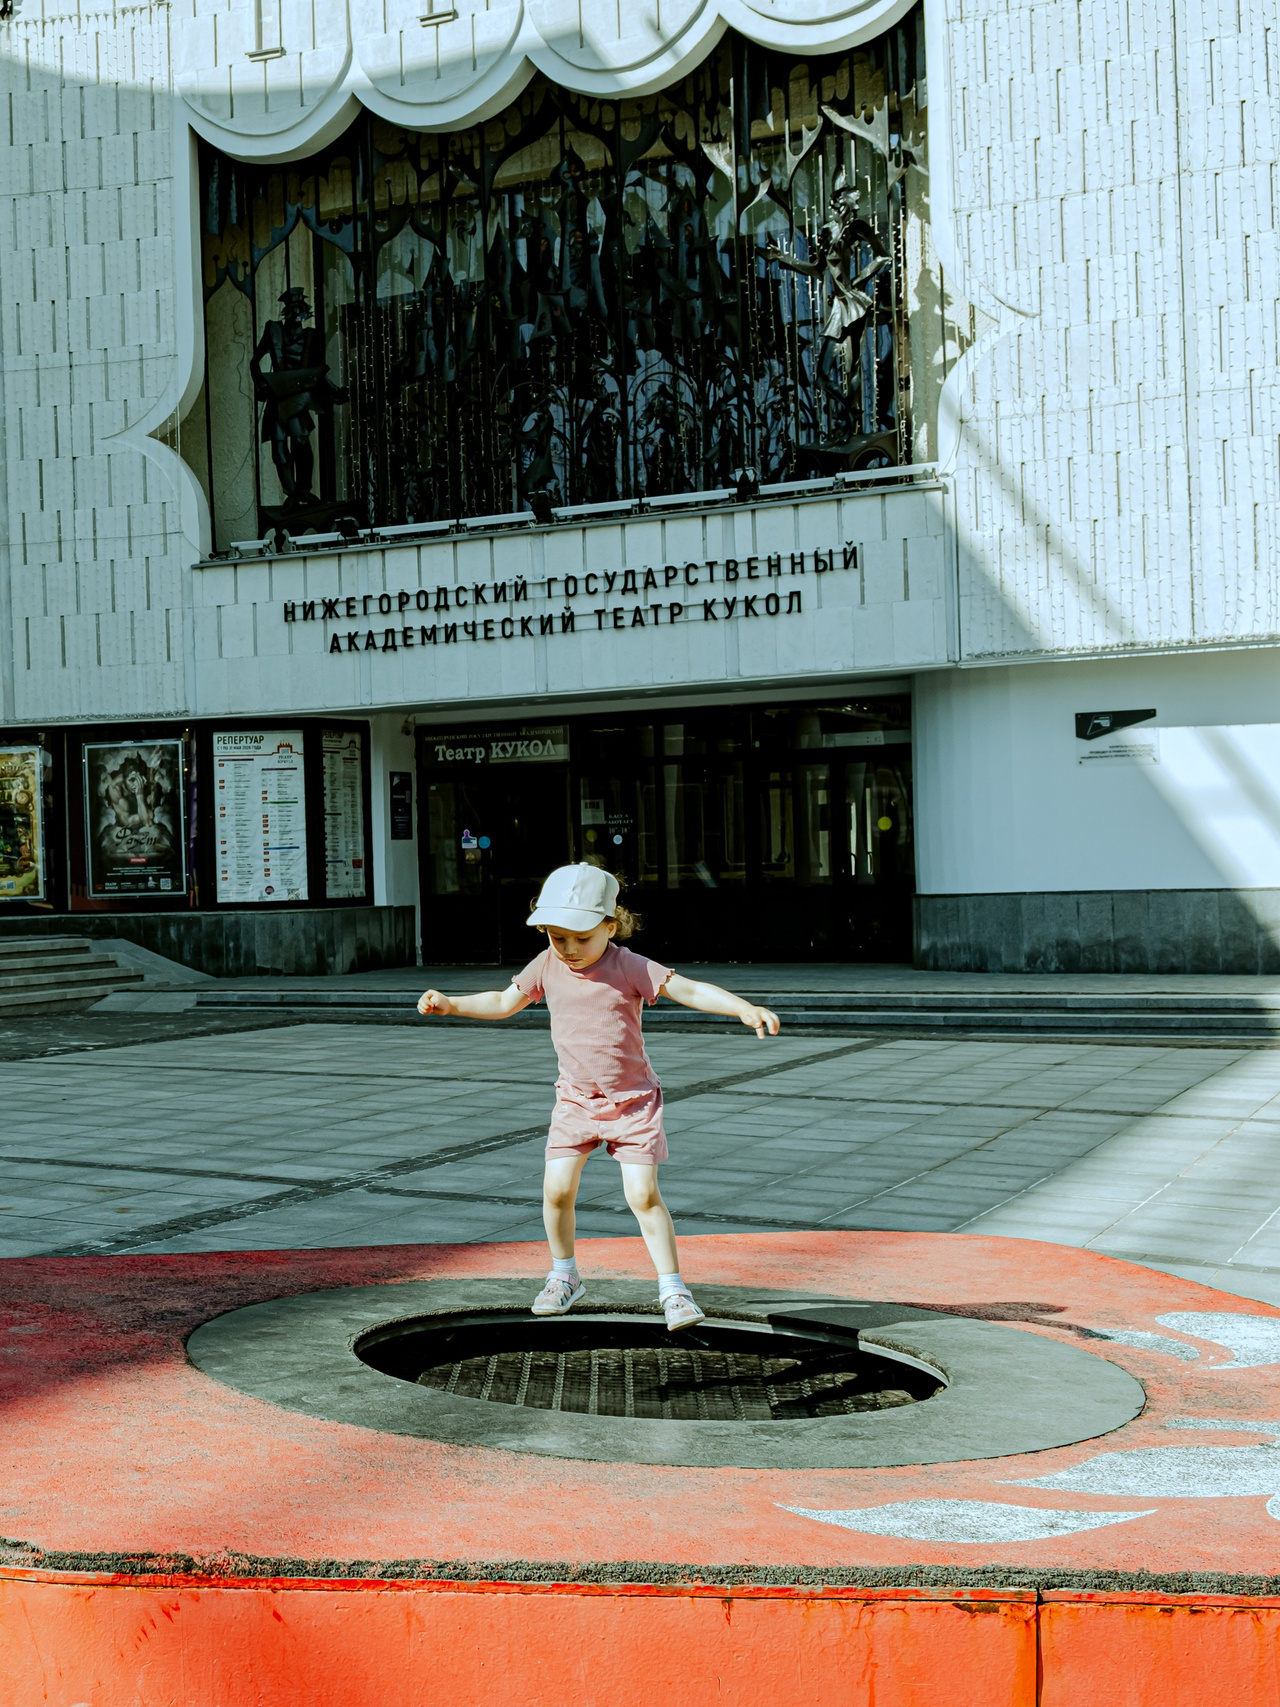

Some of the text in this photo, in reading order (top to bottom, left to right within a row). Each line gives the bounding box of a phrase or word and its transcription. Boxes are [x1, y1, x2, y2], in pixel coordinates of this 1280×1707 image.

[284, 540, 858, 622] НИЖЕГОРОДСКИЙ ГОСУДАРСТВЕННЫЙ
[329, 590, 802, 653] АКАДЕМИЧЕСКИЙ ТЕАТР КУКОЛ
[217, 735, 264, 745] РЕПЕРТУАР
[435, 739, 556, 763] Театр КУКОЛ
